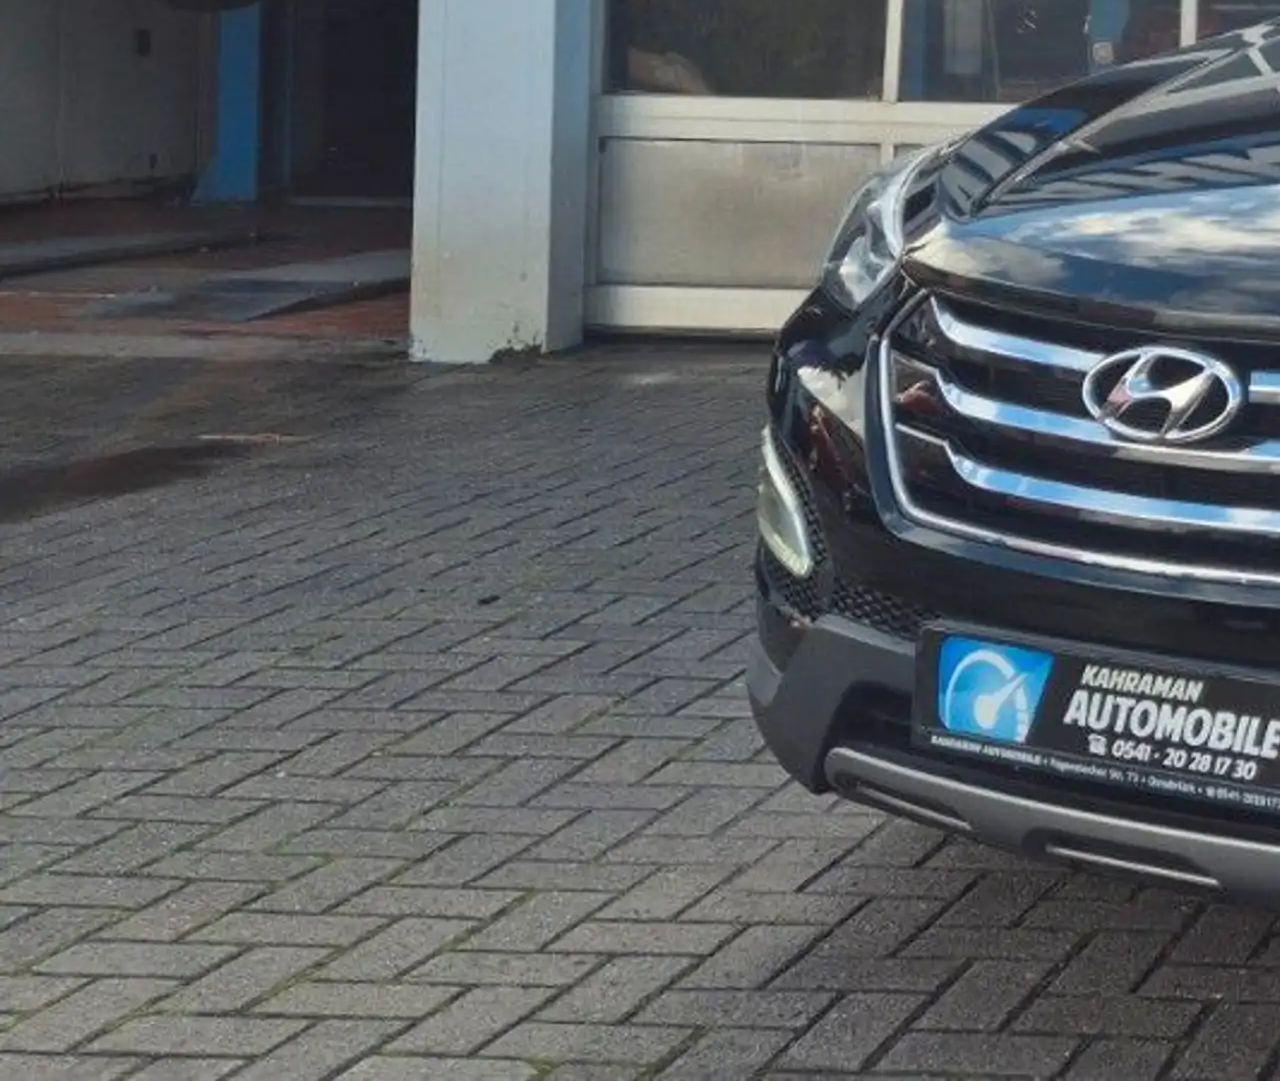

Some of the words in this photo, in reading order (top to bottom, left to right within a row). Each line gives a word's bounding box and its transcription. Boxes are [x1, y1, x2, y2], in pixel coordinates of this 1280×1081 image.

[1081, 663, 1203, 703] KAHRAMAN
[1111, 739, 1152, 761] 0541
[1162, 748, 1187, 768] 20
[1188, 752, 1211, 773] 28
[1213, 756, 1232, 776] 17
[1231, 759, 1258, 780] 30
